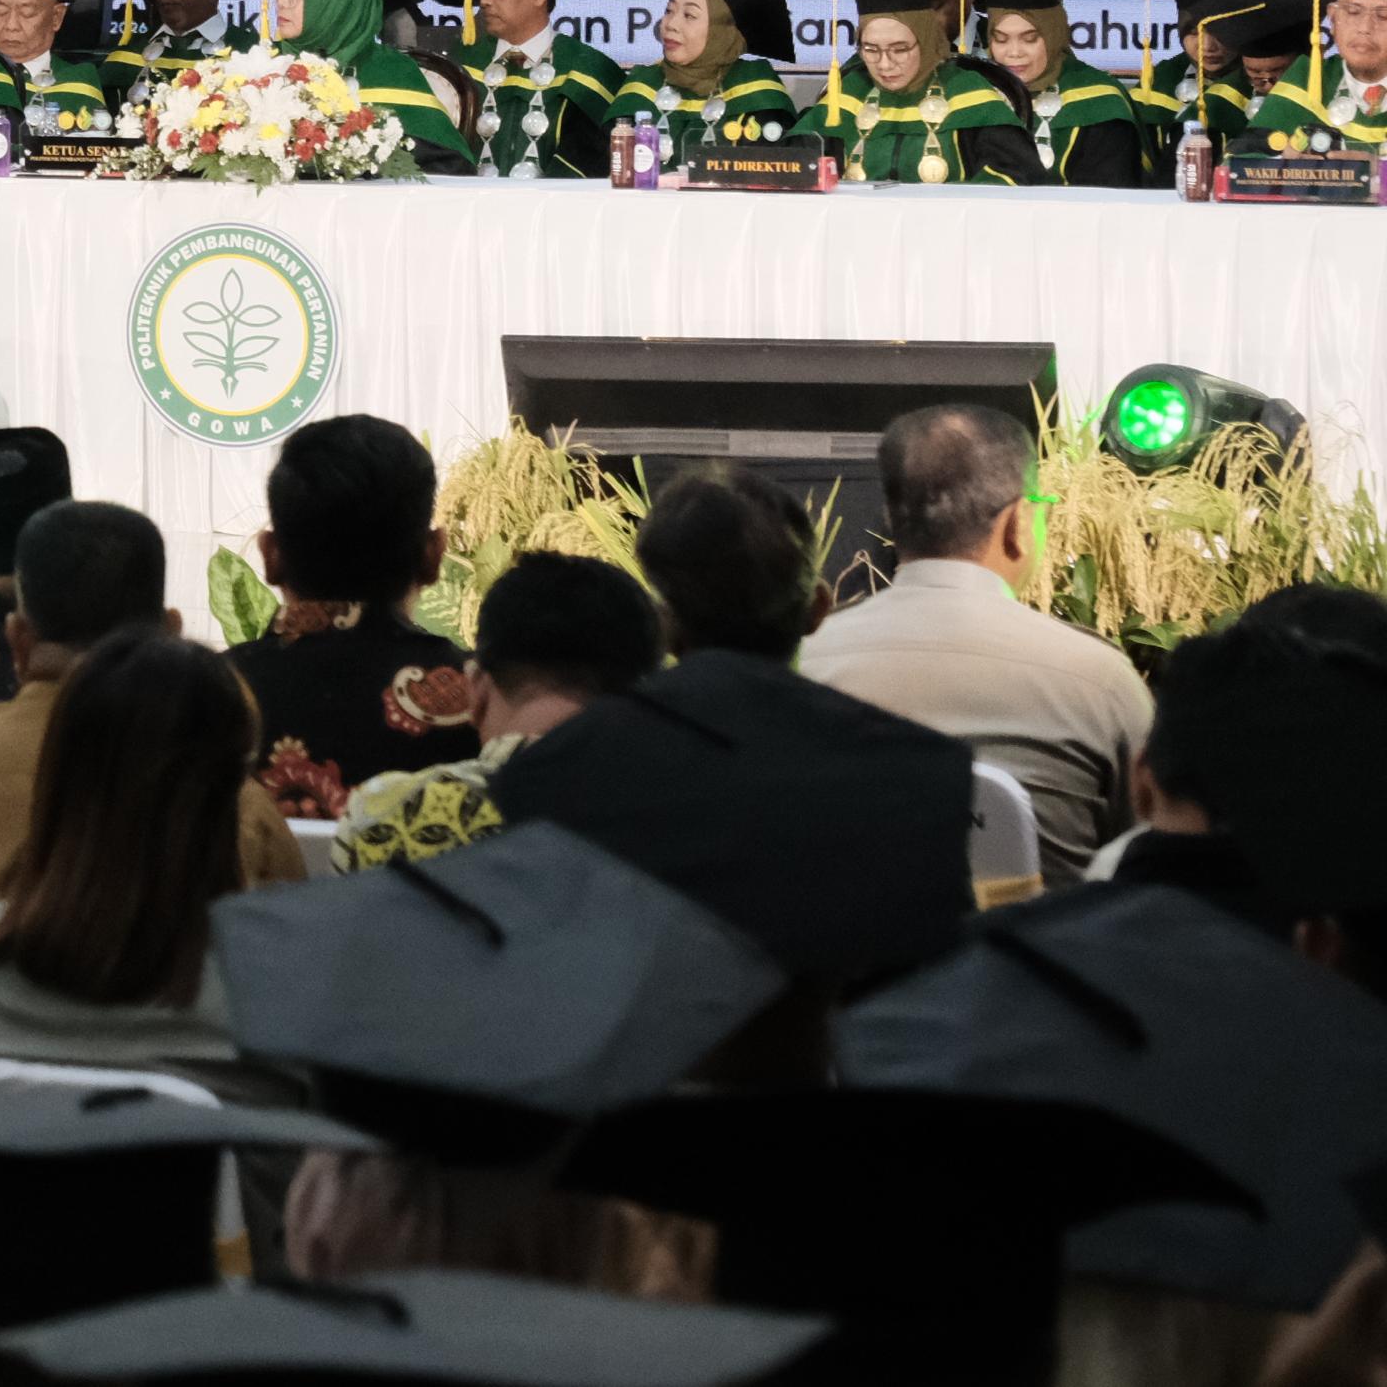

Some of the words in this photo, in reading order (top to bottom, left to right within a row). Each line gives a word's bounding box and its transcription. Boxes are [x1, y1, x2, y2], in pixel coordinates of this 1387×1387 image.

[42, 145, 85, 157] KETUA
[706, 160, 732, 172] PLT
[733, 160, 801, 173] DIREKTUR
[1243, 167, 1280, 179] WAKIL
[1282, 168, 1340, 180] DIREKTUR
[1341, 169, 1355, 181] III
[137, 265, 174, 371] POLITEKNIK
[169, 233, 300, 278] PEMBANGUNAN
[297, 273, 328, 382] PERTANIAN
[187, 411, 275, 436] GOWA
